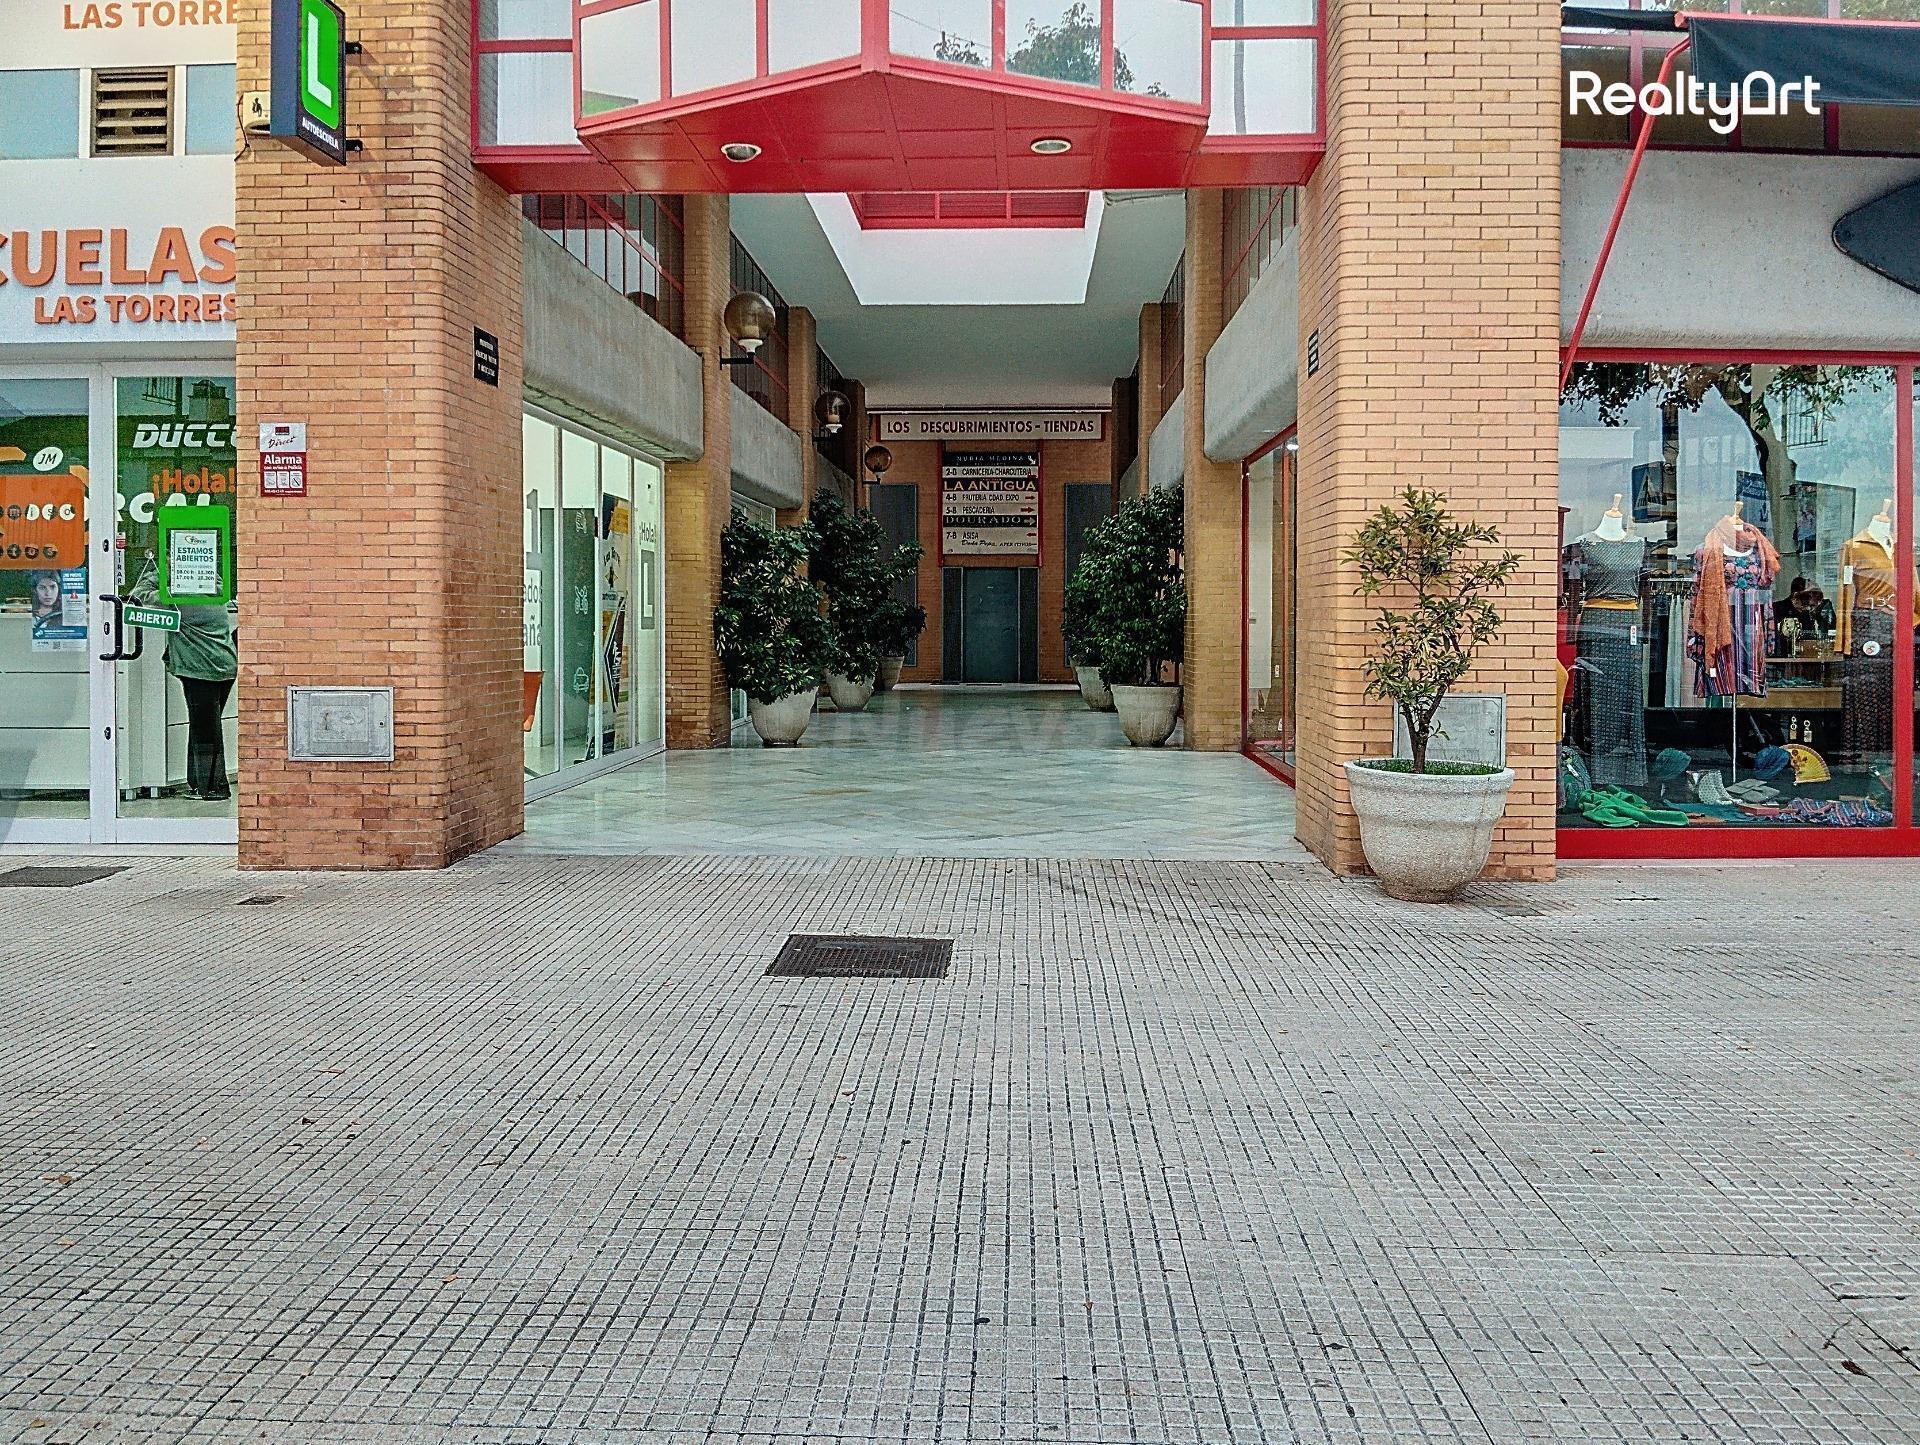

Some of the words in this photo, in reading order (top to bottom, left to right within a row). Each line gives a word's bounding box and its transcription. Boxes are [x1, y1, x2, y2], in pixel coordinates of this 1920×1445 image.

[63, 3, 123, 29] LAS
[308, 11, 332, 108] L
[302, 116, 339, 151] AUTOESCUELA
[0, 225, 236, 288] UELAS
[34, 295, 97, 324] LAS
[887, 421, 910, 434] LOS
[921, 421, 1033, 433] DESCUBRIMIENTOS
[1044, 420, 1094, 433] TIENDAS
[38, 453, 57, 465] JM
[264, 454, 303, 465] Alarma
[152, 467, 236, 500] ¡Hola!
[943, 480, 964, 491] LA
[967, 480, 1036, 491] ANTIGUA
[946, 516, 1021, 524] DOURADO
[962, 531, 979, 540] ASISA
[177, 547, 214, 555] ESTAMOS
[176, 554, 214, 563] ABIERTOS
[128, 610, 174, 626] ABIERTO
